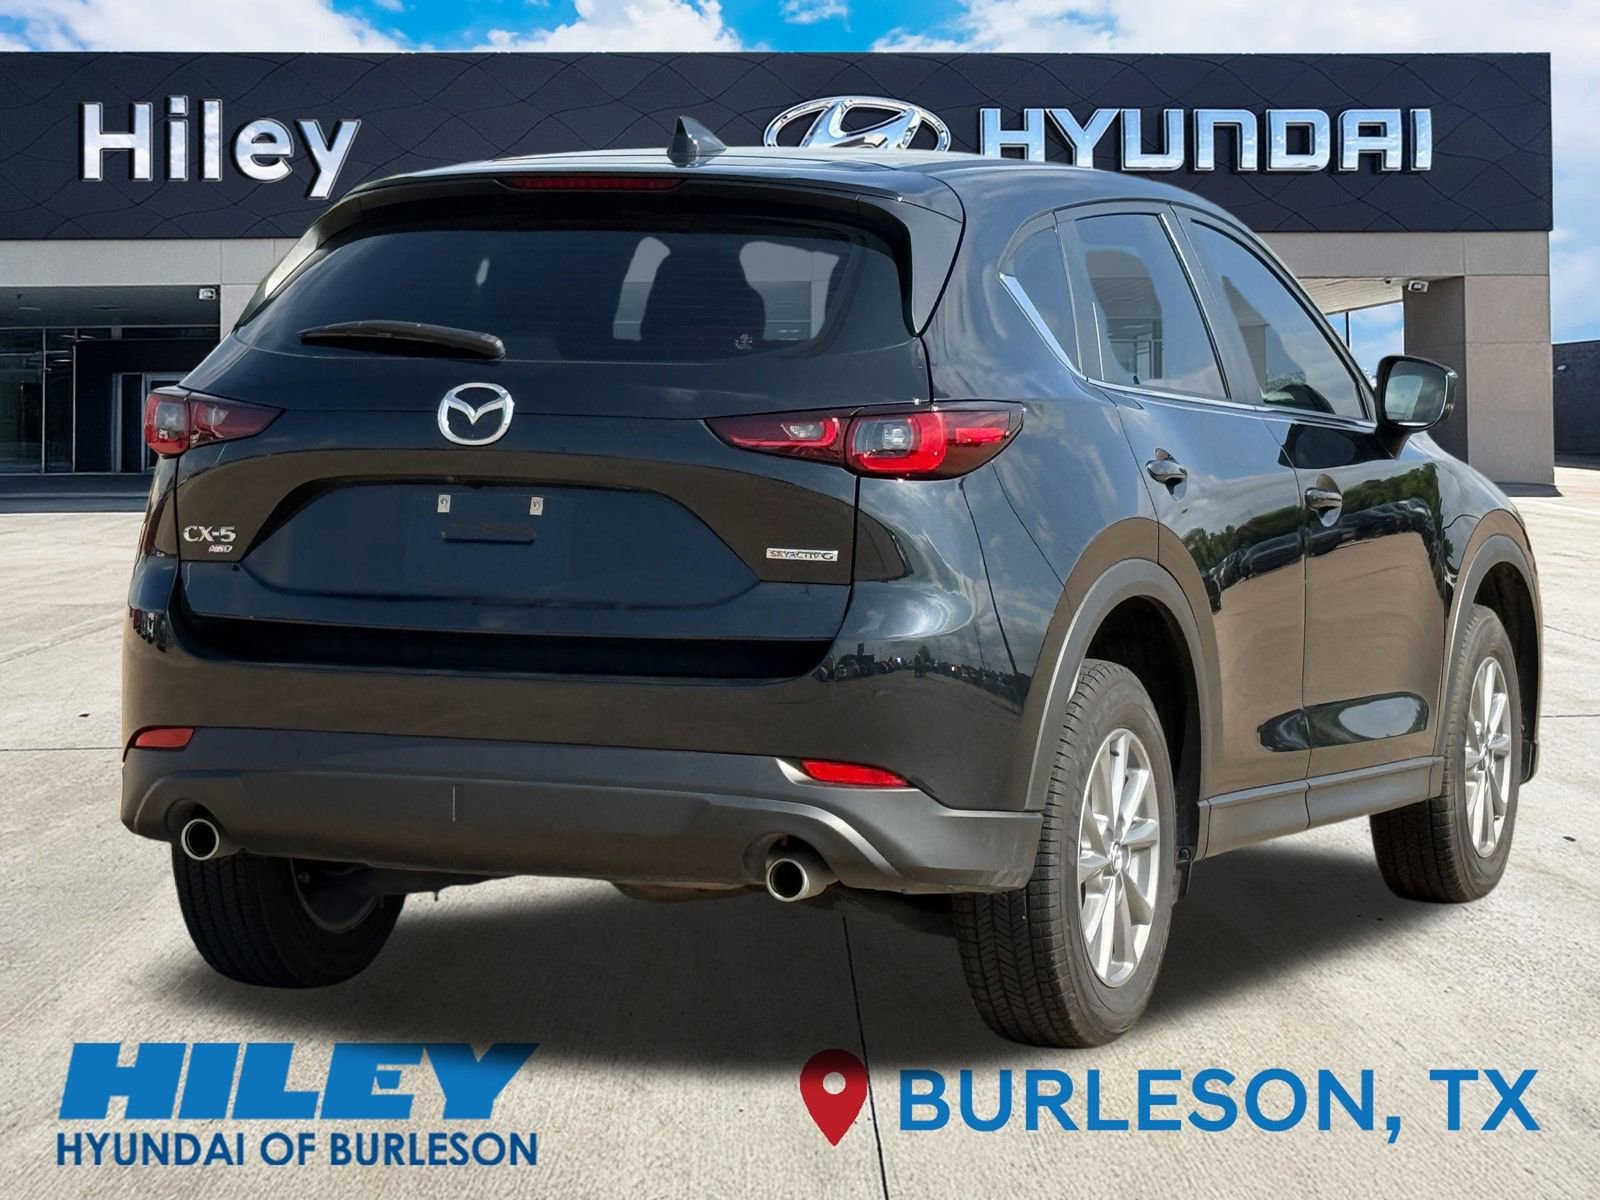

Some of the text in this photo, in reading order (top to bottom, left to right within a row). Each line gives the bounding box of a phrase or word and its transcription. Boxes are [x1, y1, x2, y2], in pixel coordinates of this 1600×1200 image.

[79, 95, 361, 199] Hiley
[979, 108, 1432, 172] HYUNDAI
[183, 525, 236, 542] CX-5
